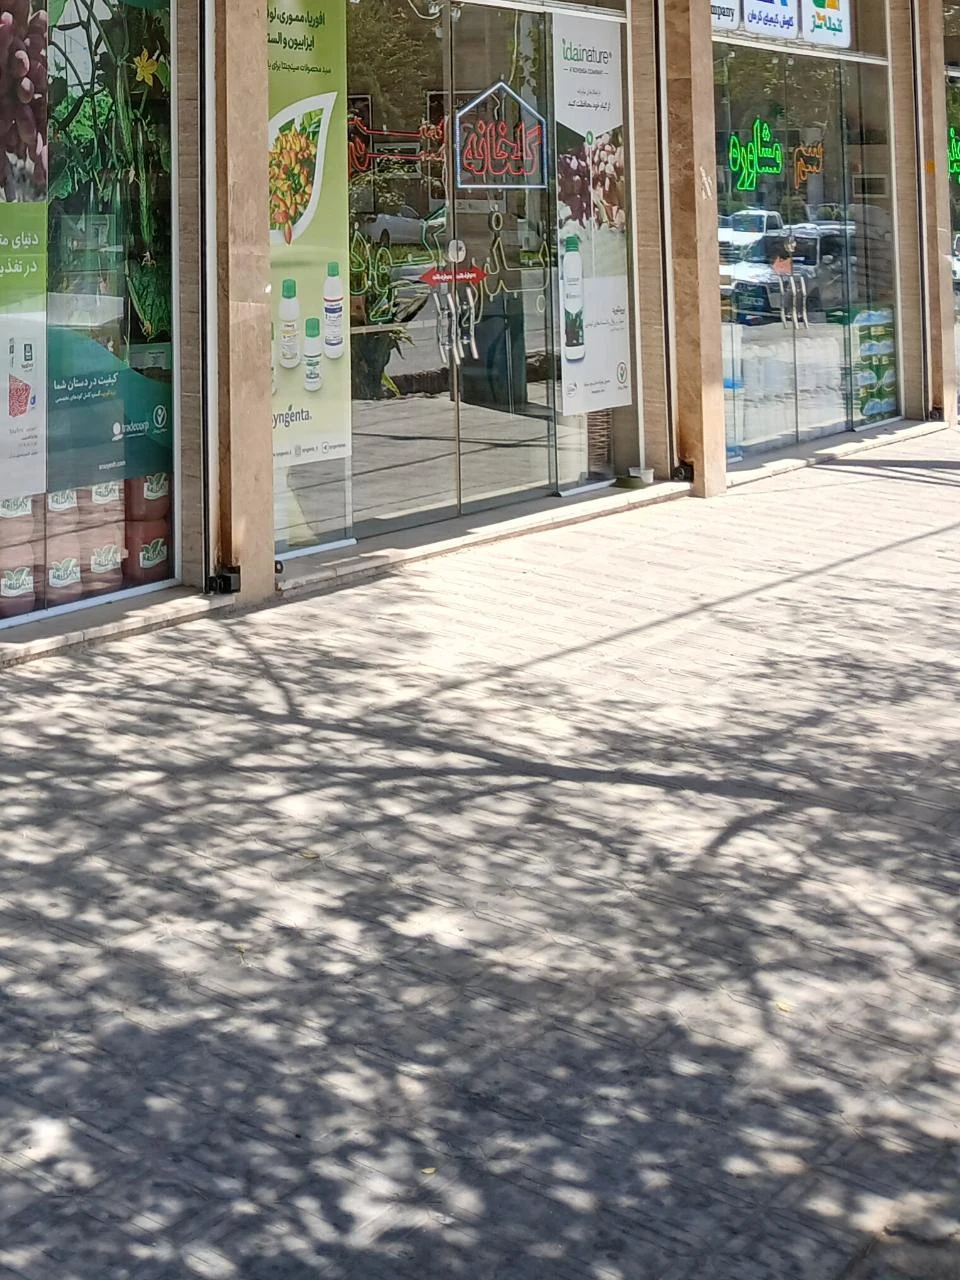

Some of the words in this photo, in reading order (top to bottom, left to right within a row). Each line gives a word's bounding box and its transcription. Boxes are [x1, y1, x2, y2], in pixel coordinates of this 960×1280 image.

[11, 231, 39, 249] دنیای
[24, 261, 38, 277] در
[53, 379, 67, 390] شما
[121, 421, 150, 433] tradecorp
